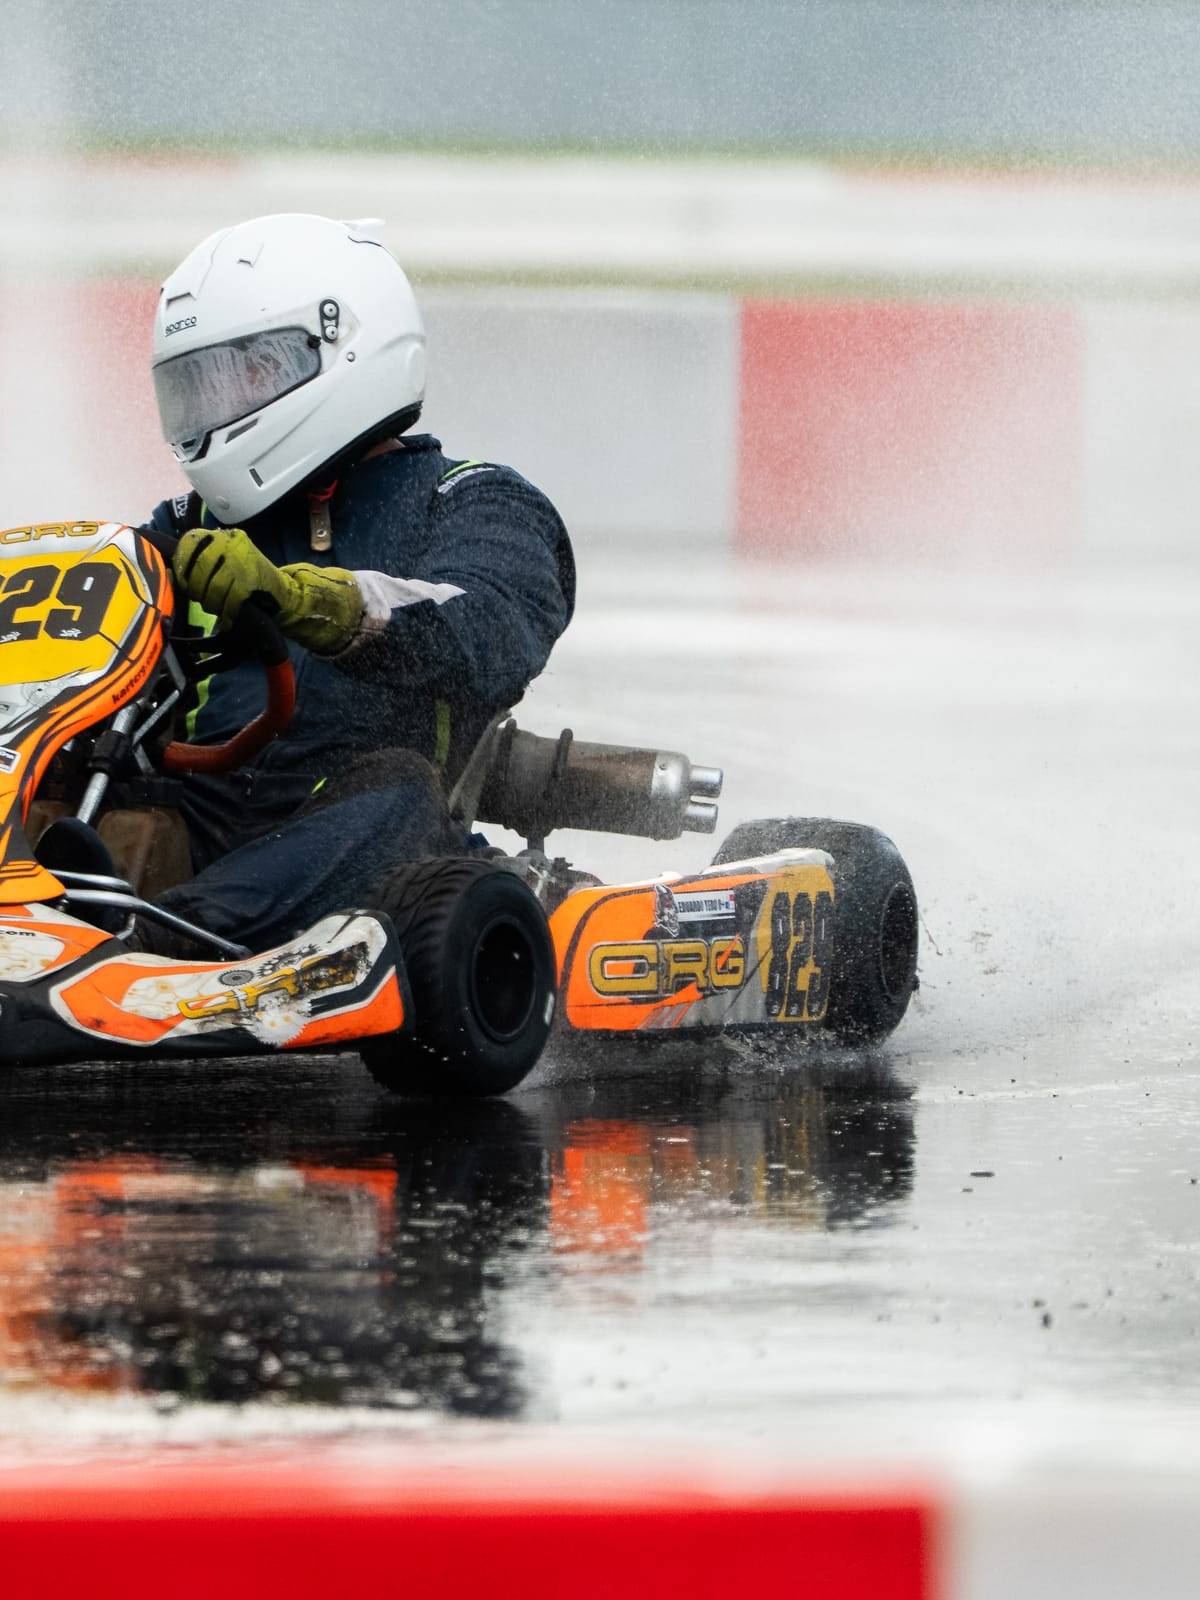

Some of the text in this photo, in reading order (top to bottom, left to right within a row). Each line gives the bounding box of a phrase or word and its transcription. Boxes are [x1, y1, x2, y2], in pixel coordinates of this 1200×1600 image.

[164, 315, 197, 336] sparco
[0, 521, 100, 545] CRG
[589, 938, 745, 997] CRG
[764, 891, 835, 1017] 829
